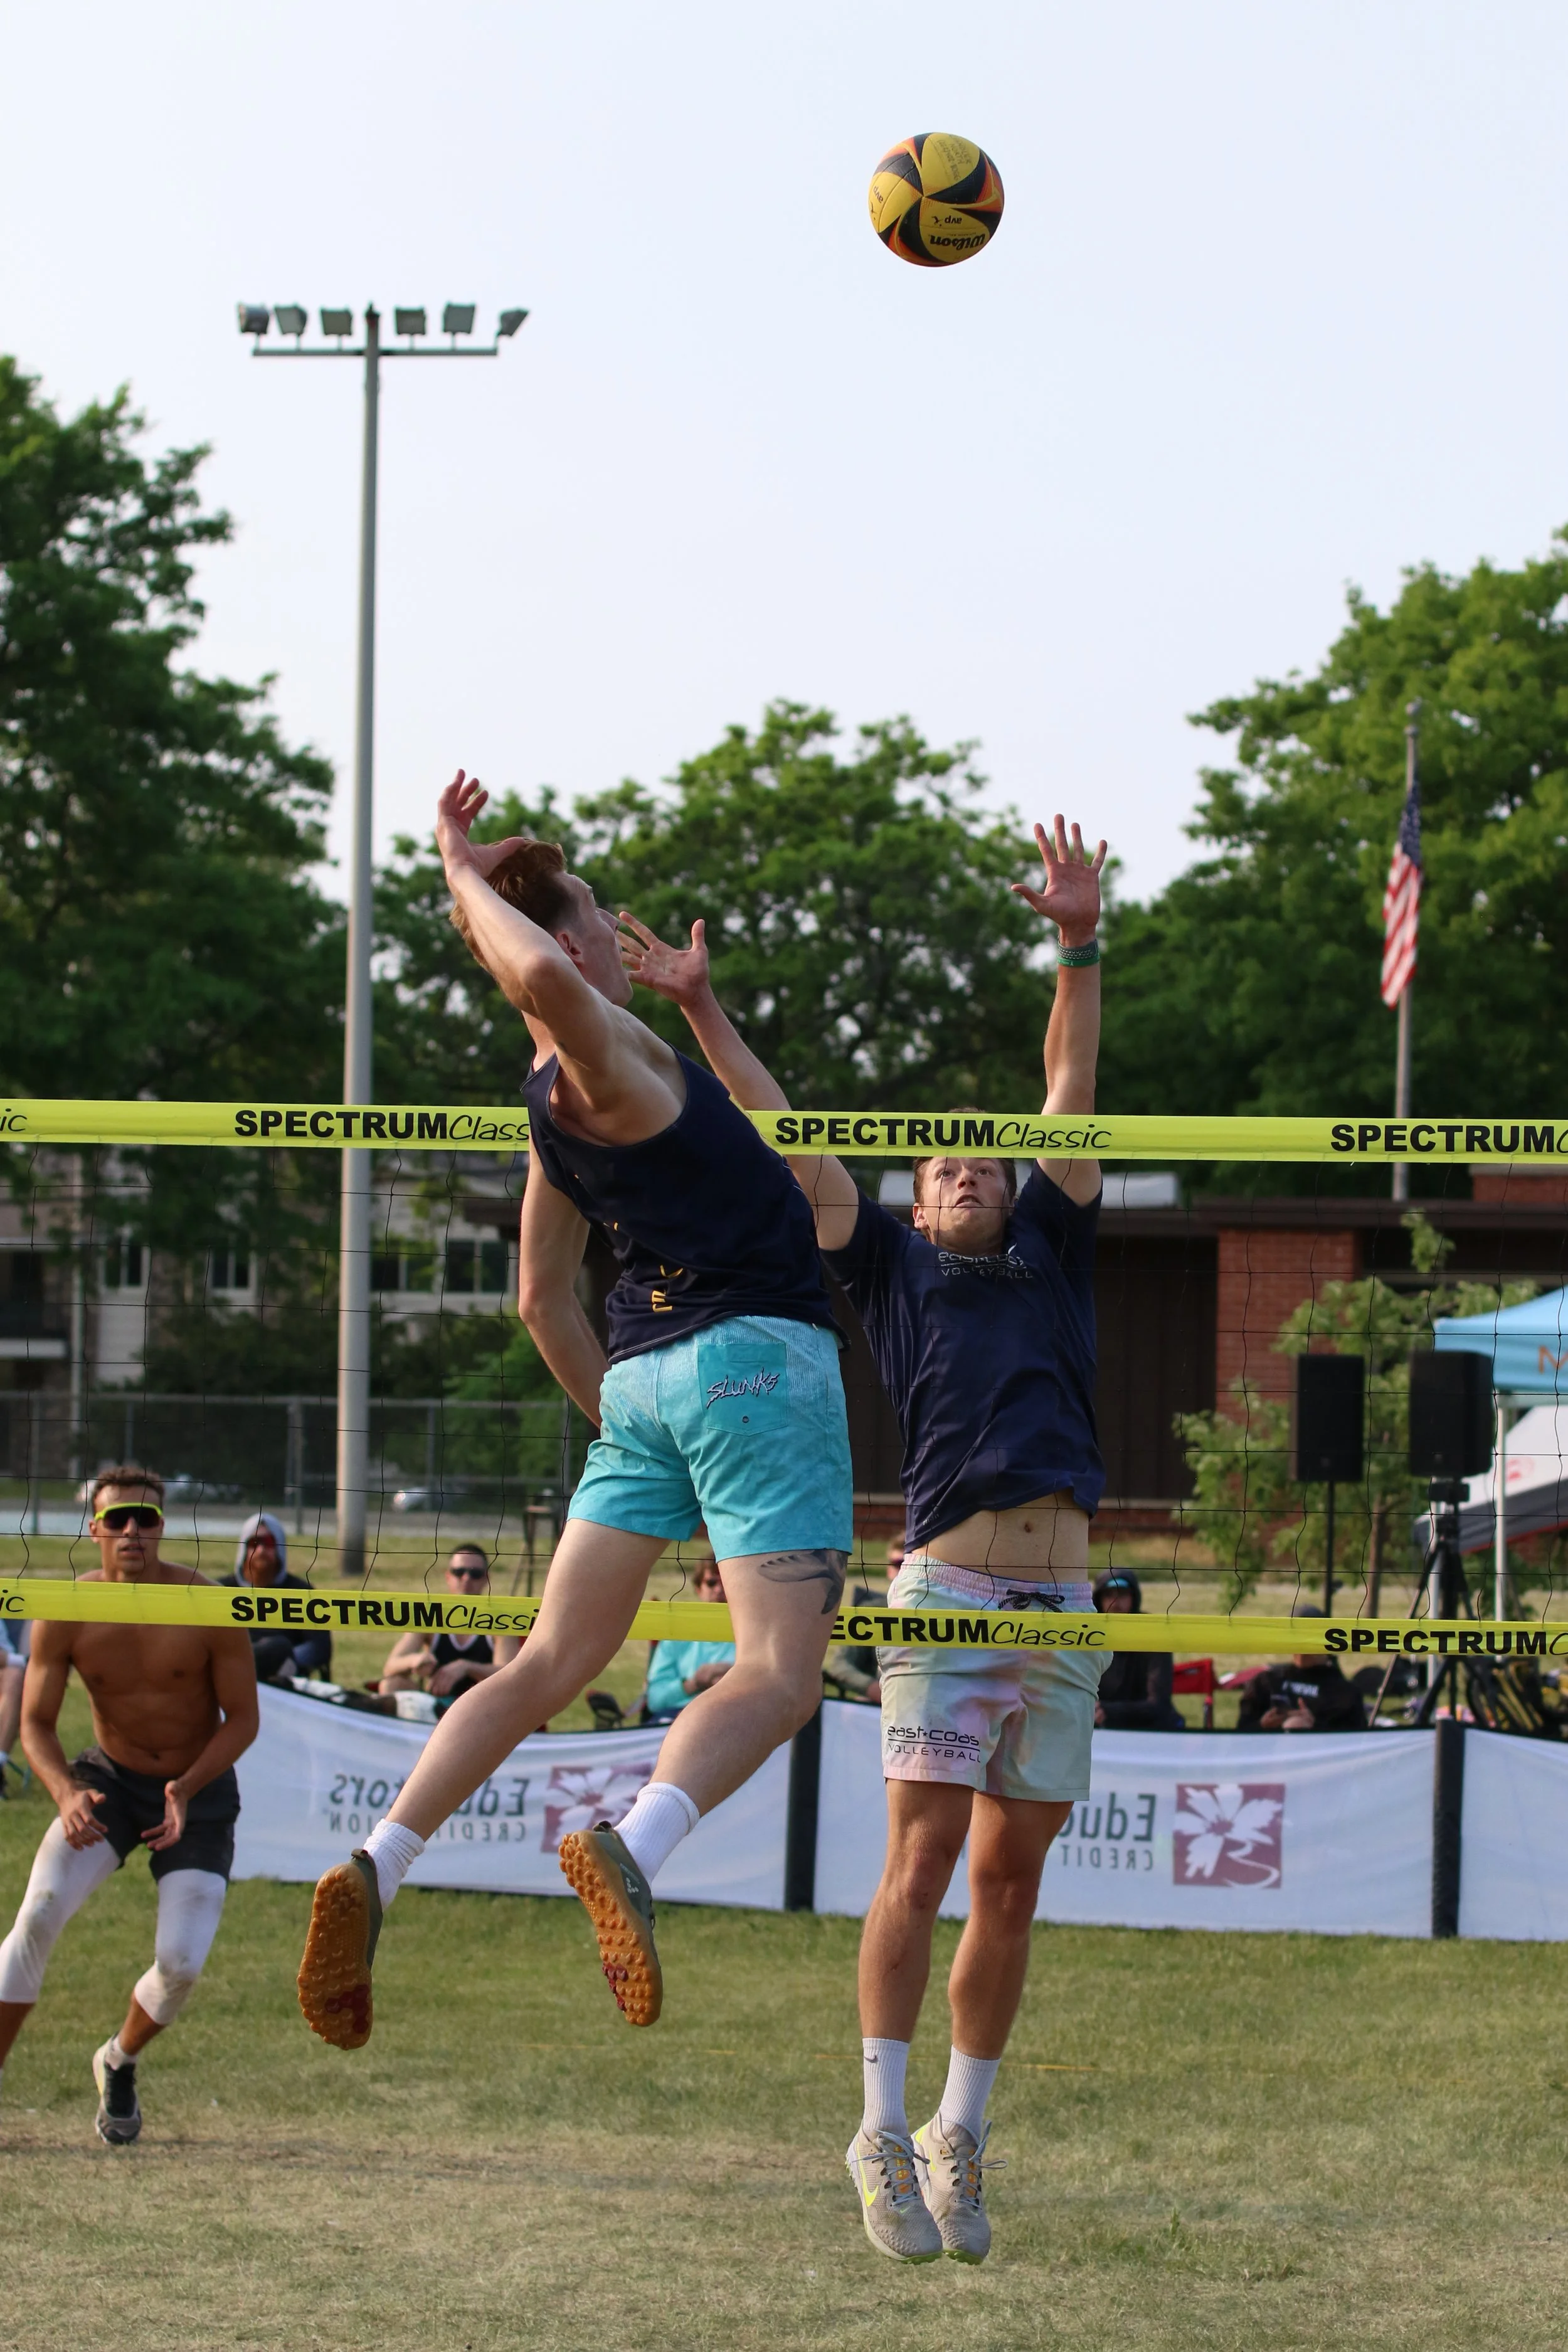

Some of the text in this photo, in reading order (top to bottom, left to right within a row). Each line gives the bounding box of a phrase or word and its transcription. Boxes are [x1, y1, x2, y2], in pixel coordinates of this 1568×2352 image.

[945, 215, 962, 225] avp
[930, 233, 986, 251] Wilson
[928, 1729, 980, 1747] coas
